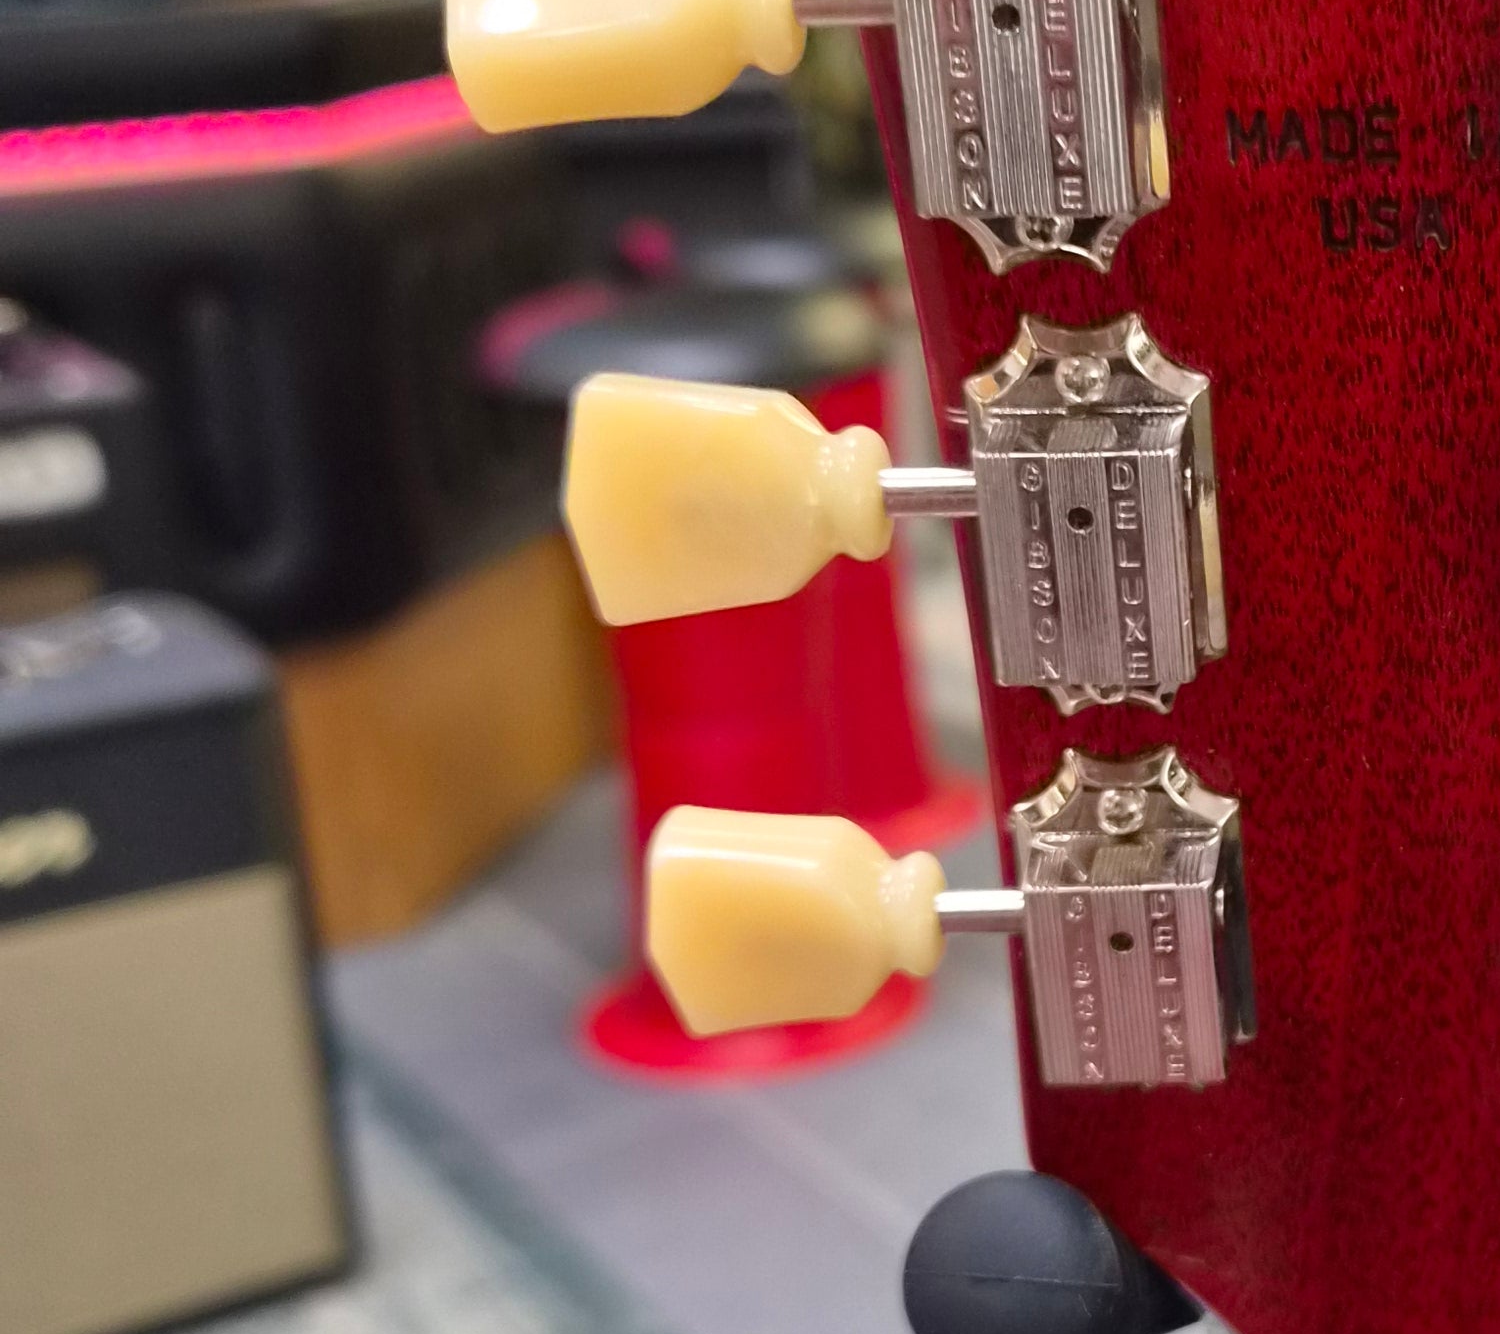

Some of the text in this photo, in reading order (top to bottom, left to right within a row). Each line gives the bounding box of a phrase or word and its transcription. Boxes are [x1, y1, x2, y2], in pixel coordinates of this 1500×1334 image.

[1225, 105, 1401, 165] MADE
[1315, 194, 1451, 252] USA
[1020, 460, 1061, 681] GIBSON
[1110, 459, 1150, 680] DELUXE
[1150, 893, 1187, 1077] DELUXE
